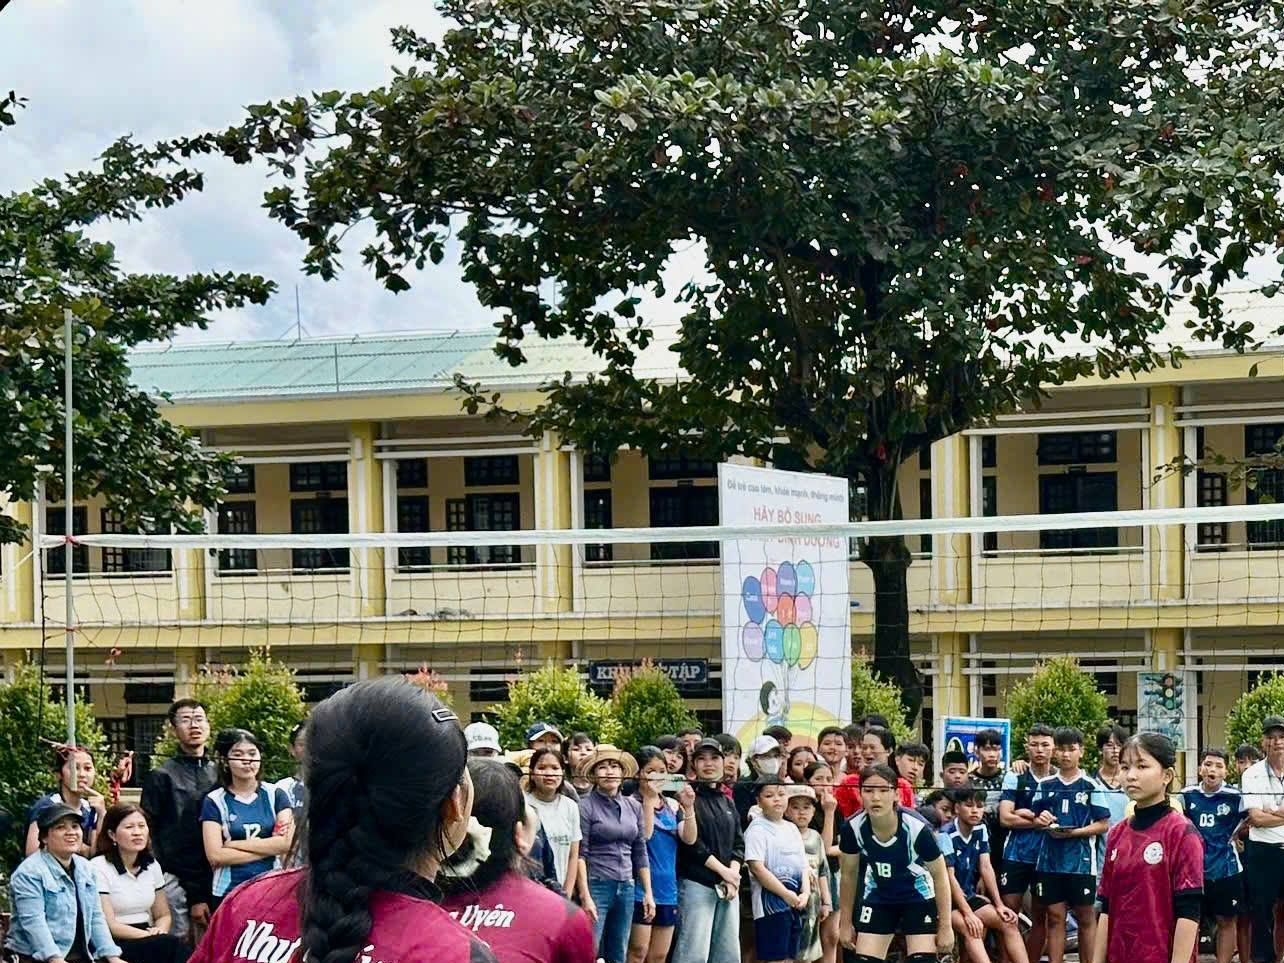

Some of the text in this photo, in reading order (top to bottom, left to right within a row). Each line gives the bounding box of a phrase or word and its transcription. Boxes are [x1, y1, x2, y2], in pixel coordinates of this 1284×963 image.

[794, 510, 822, 524] SUNG
[1200, 813, 1216, 828] 03
[242, 822, 262, 840] 12
[875, 861, 892, 878] 18
[460, 903, 516, 932] Uyên
